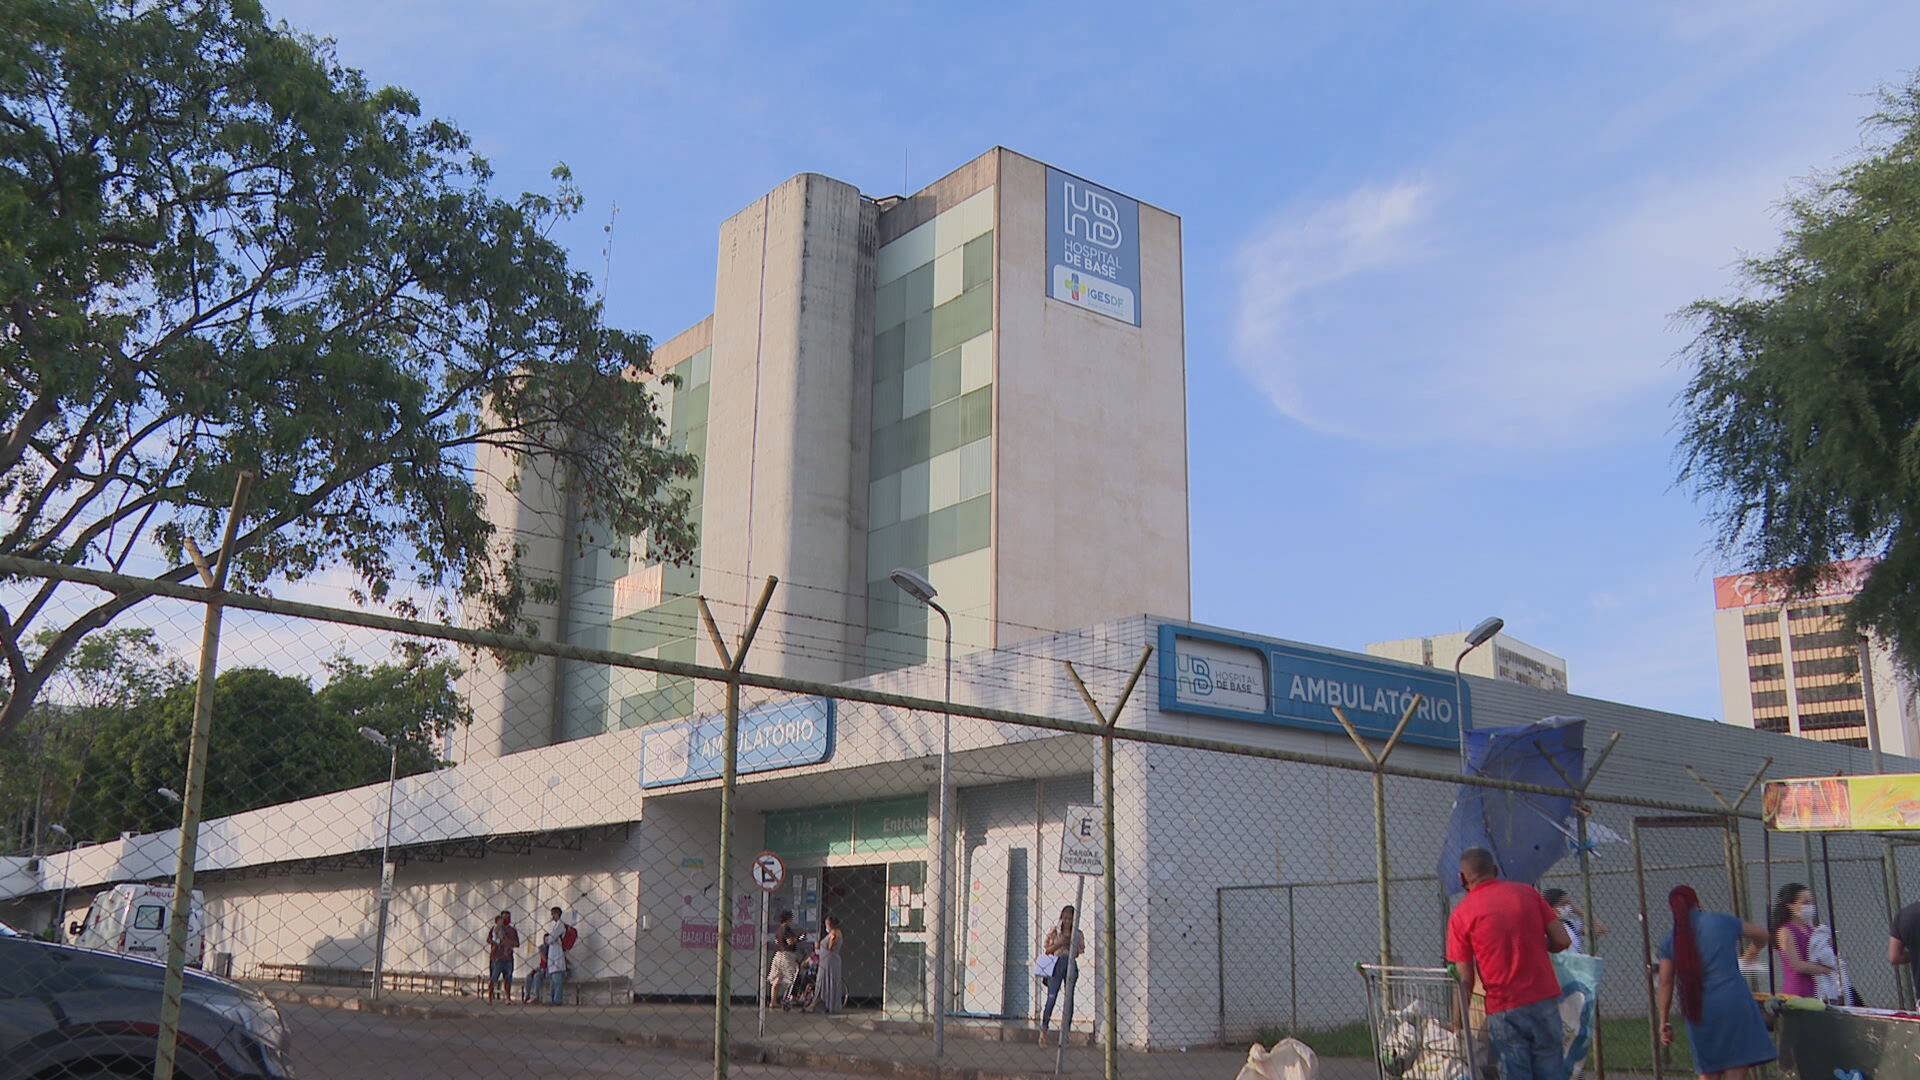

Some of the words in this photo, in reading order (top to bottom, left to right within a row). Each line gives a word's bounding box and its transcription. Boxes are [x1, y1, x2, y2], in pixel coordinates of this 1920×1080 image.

[1064, 238, 1122, 270] HOSPITAL
[1064, 251, 1081, 267] DE
[1084, 258, 1116, 280] BASE
[1087, 287, 1124, 307] IGESDF
[1215, 671, 1259, 686] HOSPITAL
[1216, 680, 1228, 690] DE
[1229, 683, 1252, 694] BASE
[1288, 674, 1452, 723] AMBULATÓRIO
[701, 718, 814, 758] AMULATÓRIO
[1081, 817, 1093, 836] E
[144, 891, 195, 900] AMBULA
